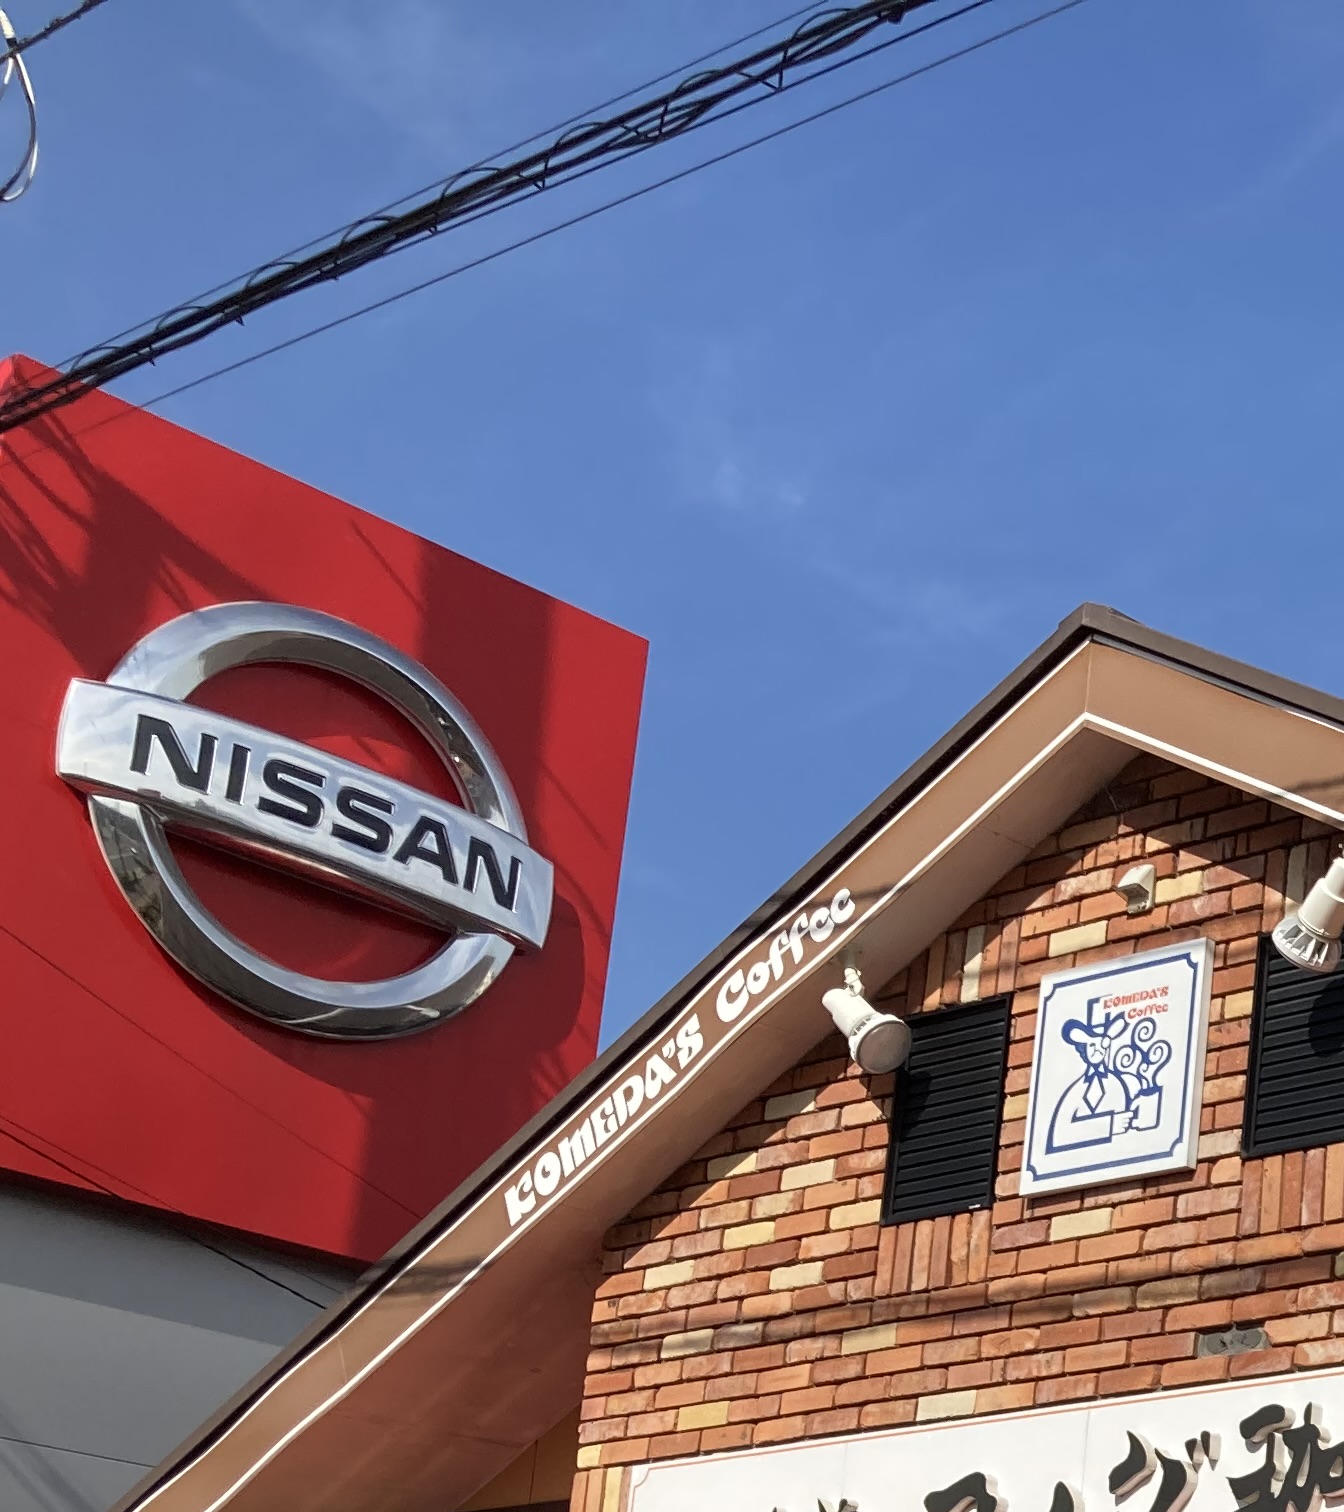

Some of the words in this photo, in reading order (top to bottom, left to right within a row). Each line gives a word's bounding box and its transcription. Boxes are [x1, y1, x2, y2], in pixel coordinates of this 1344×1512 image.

[130, 714, 525, 915] NISSAN
[504, 1013, 704, 1227] KOMEDA'S
[716, 887, 856, 1023] Coffee
[1127, 1003, 1169, 1019] Coffee
